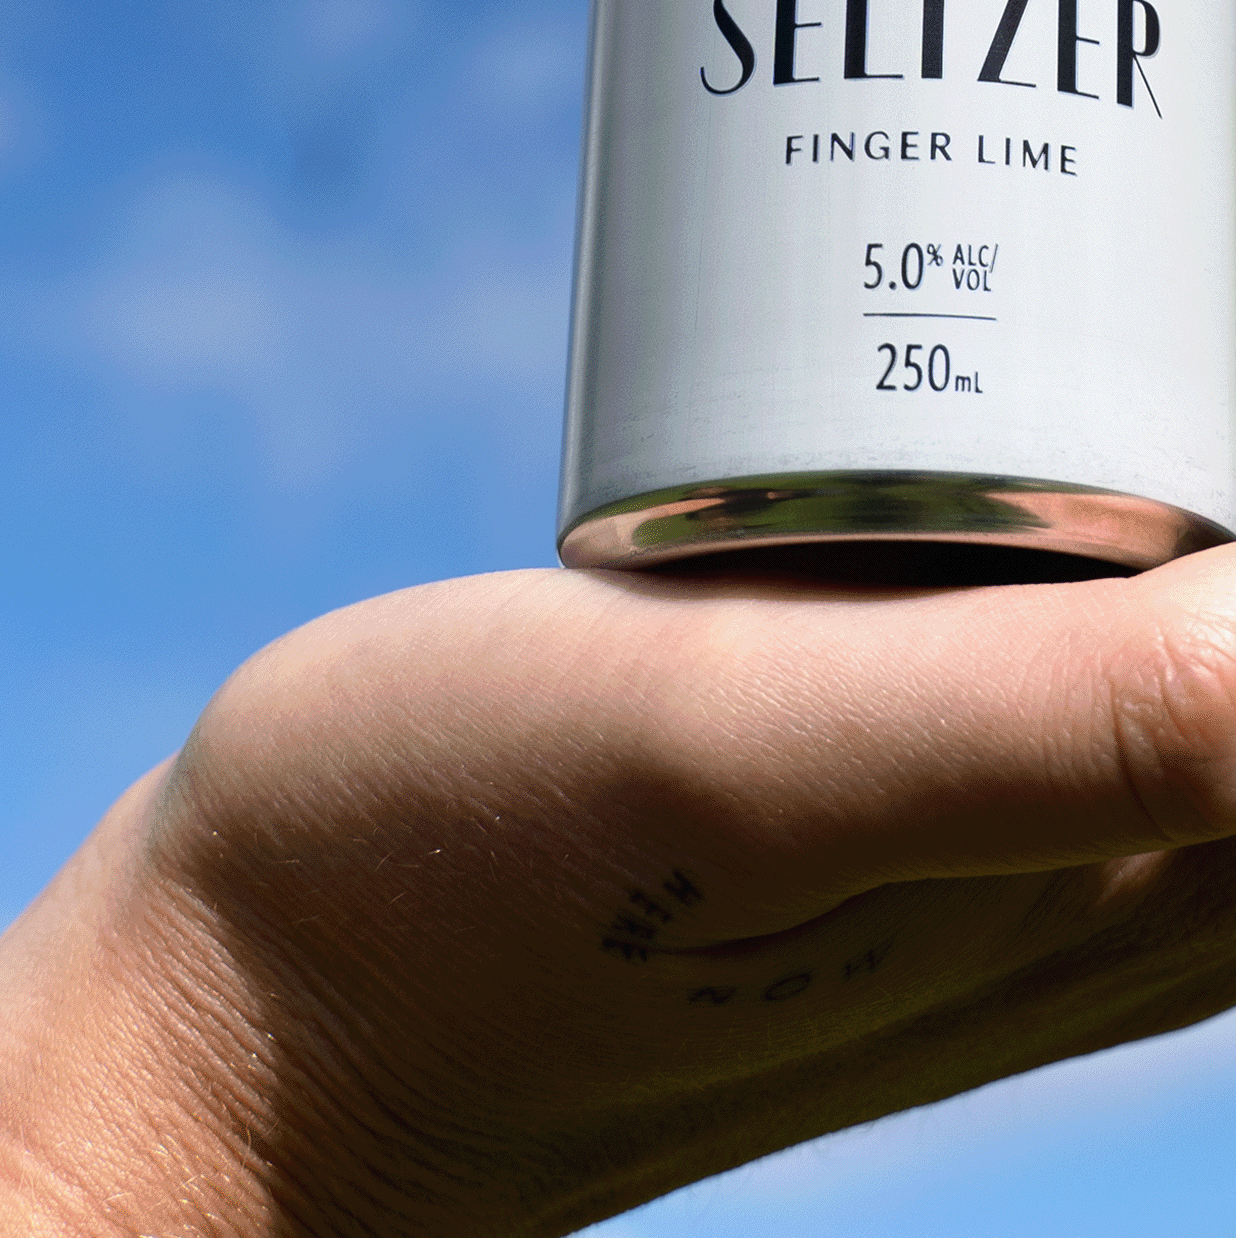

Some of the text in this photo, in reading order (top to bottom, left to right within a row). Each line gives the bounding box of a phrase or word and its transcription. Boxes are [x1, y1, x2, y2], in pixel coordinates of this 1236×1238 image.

[785, 130, 1079, 177] FINGER LIME
[863, 241, 999, 291] 5.0% ALC/
[951, 267, 992, 292] VOL
